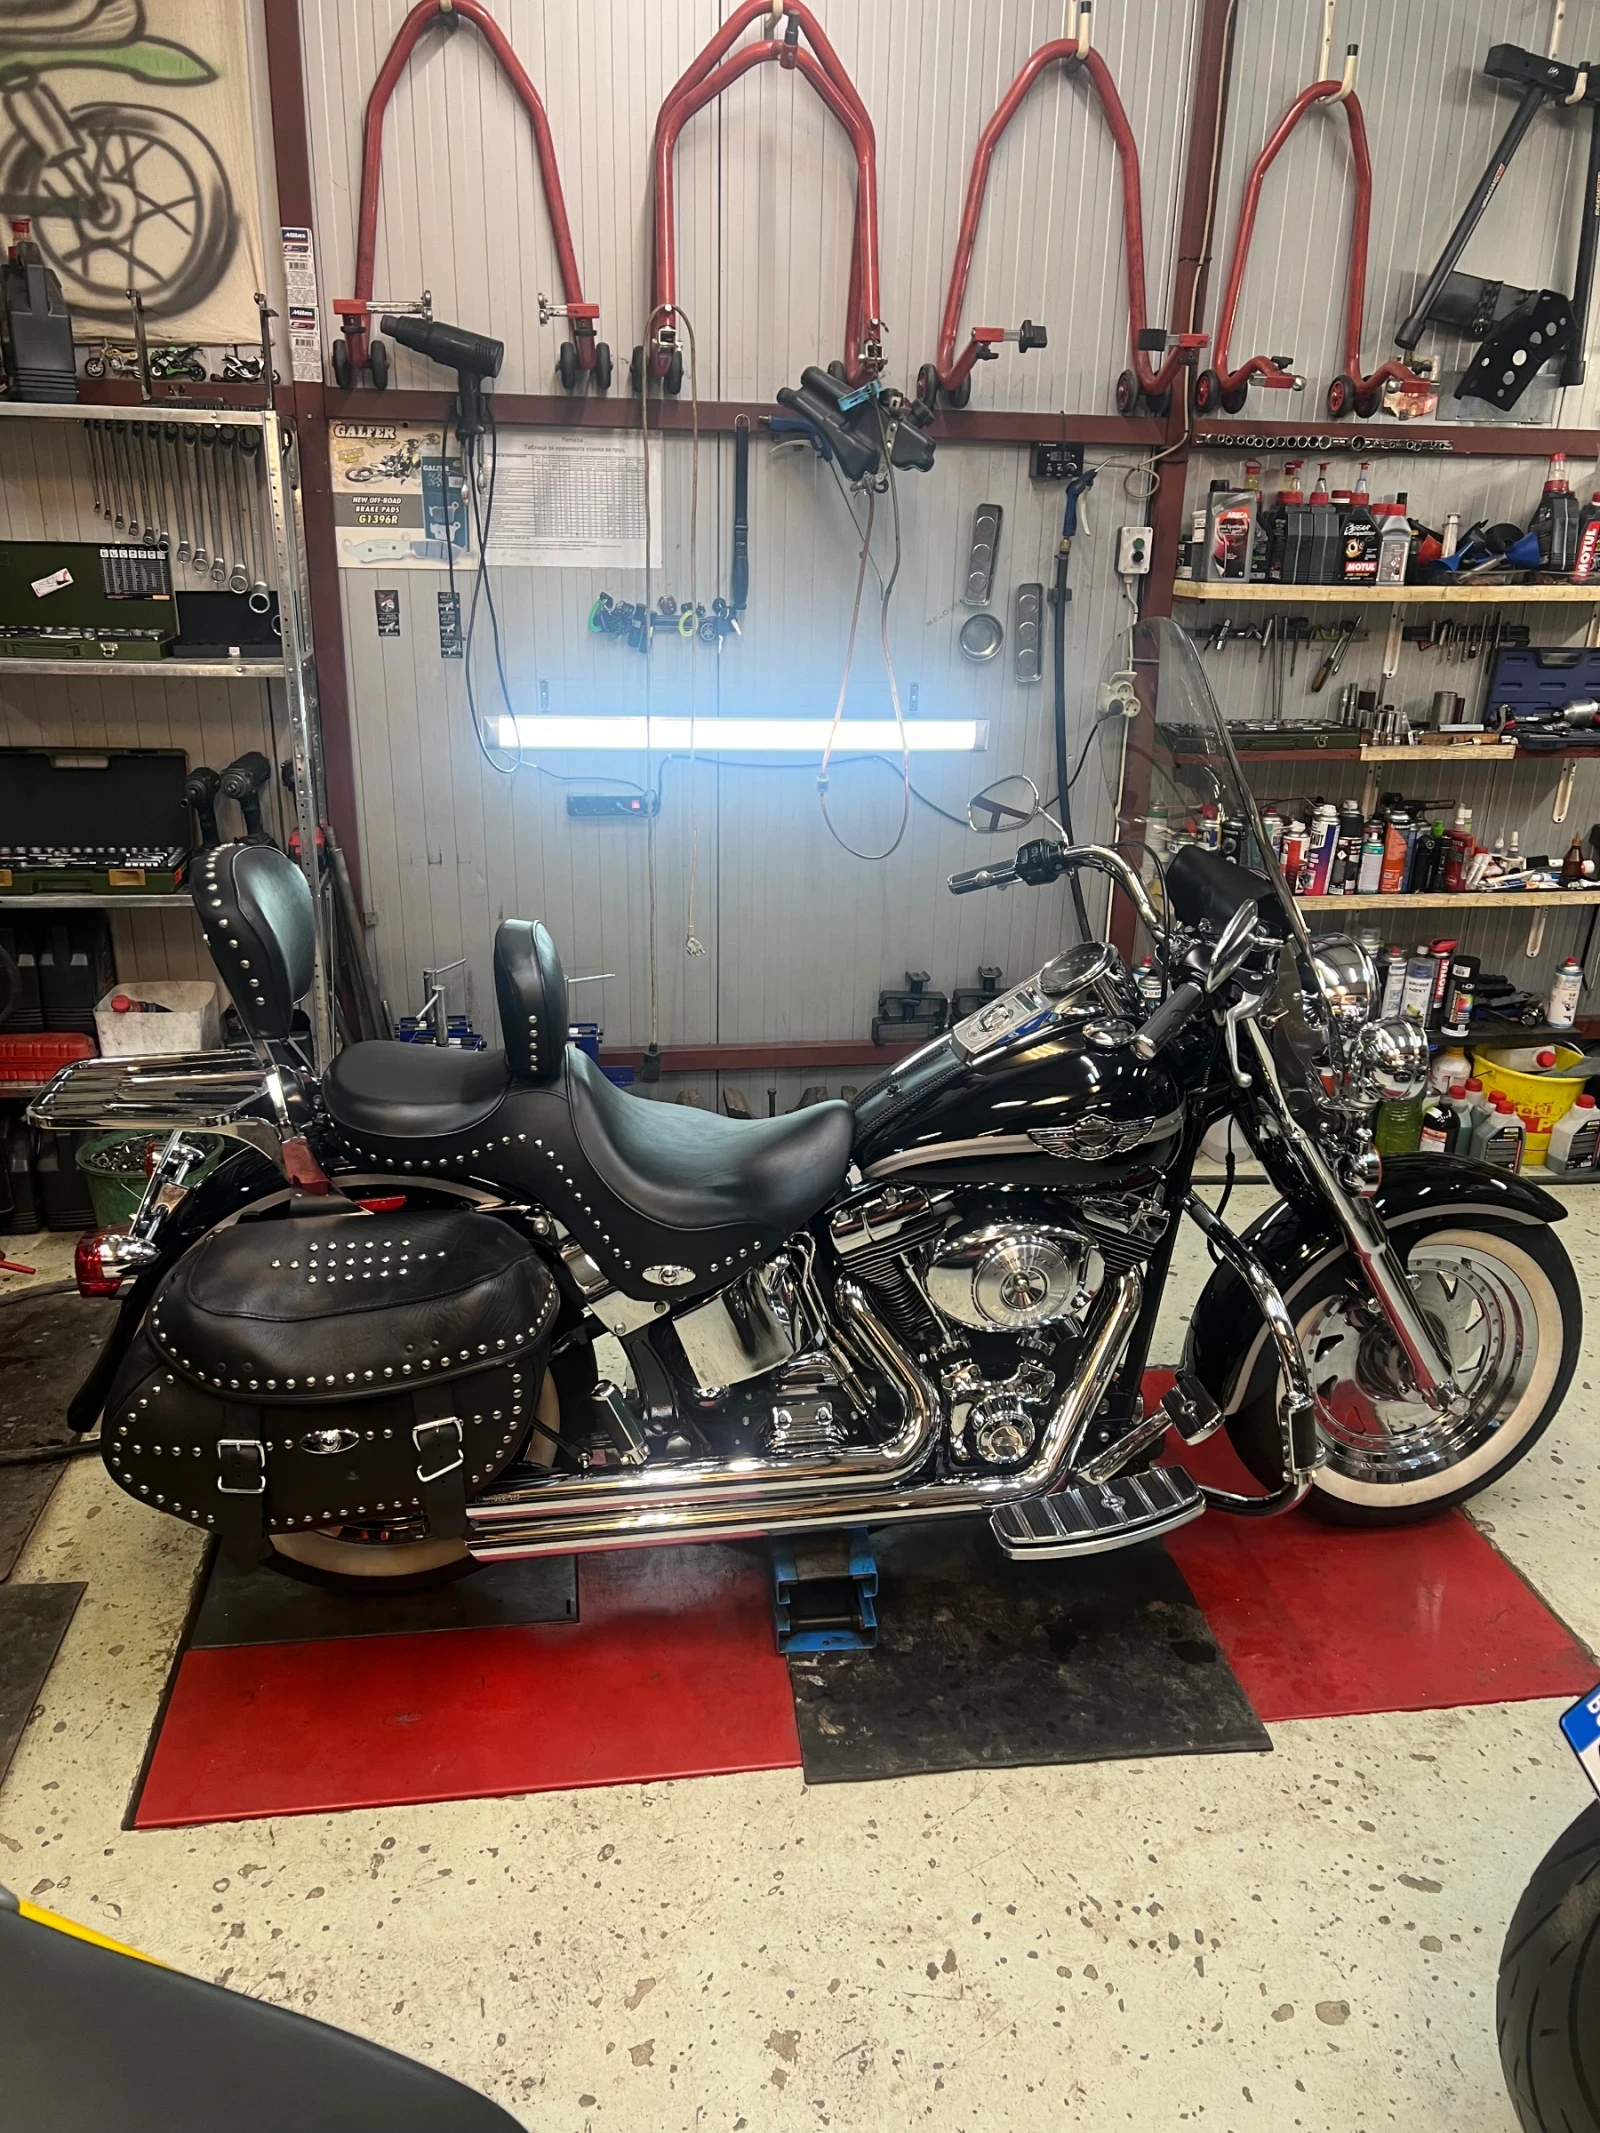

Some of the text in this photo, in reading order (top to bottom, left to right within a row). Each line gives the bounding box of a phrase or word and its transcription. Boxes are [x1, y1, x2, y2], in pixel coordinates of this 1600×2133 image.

[334, 424, 397, 439] GALFER
[524, 443, 547, 452] Таблица
[352, 496, 402, 504] NEW OFF-ROAD
[355, 505, 379, 513] BRAKE
[358, 514, 399, 524] G1396R
[1578, 528, 1597, 577] MOTUL
[1347, 562, 1376, 571] MOTUL
[1437, 959, 1450, 996] MOTUL
